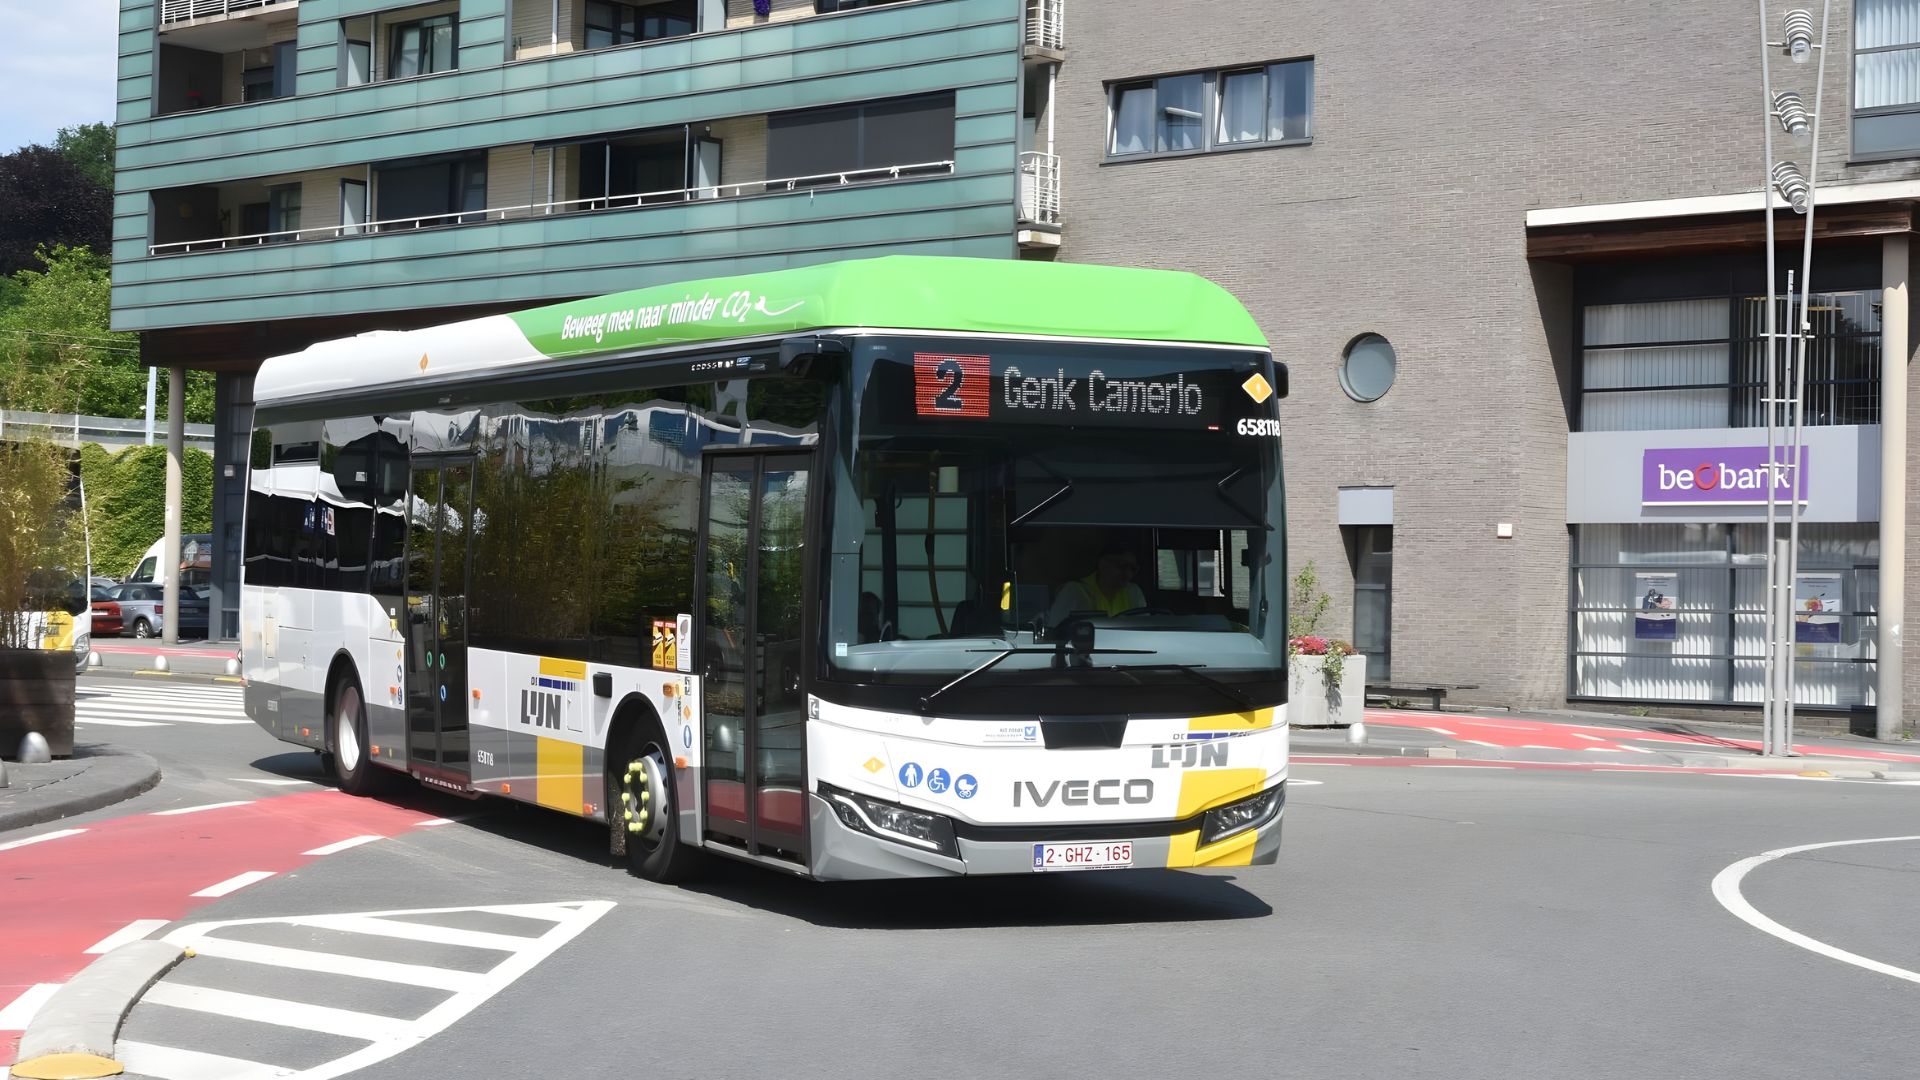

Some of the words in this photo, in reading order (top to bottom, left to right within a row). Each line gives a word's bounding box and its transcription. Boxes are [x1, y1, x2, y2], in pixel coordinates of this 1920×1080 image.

[561, 310, 607, 343] Beweeg
[606, 308, 634, 333] mee
[634, 303, 668, 330] naar
[668, 293, 722, 325] minder
[934, 358, 964, 411] 2
[1003, 366, 1077, 410] Genk
[1089, 369, 1202, 415] Camerlo
[1237, 418, 1281, 437] 658118
[520, 689, 562, 730] LIJN
[1151, 742, 1229, 769] LIJN
[1013, 778, 1154, 808] IVECO
